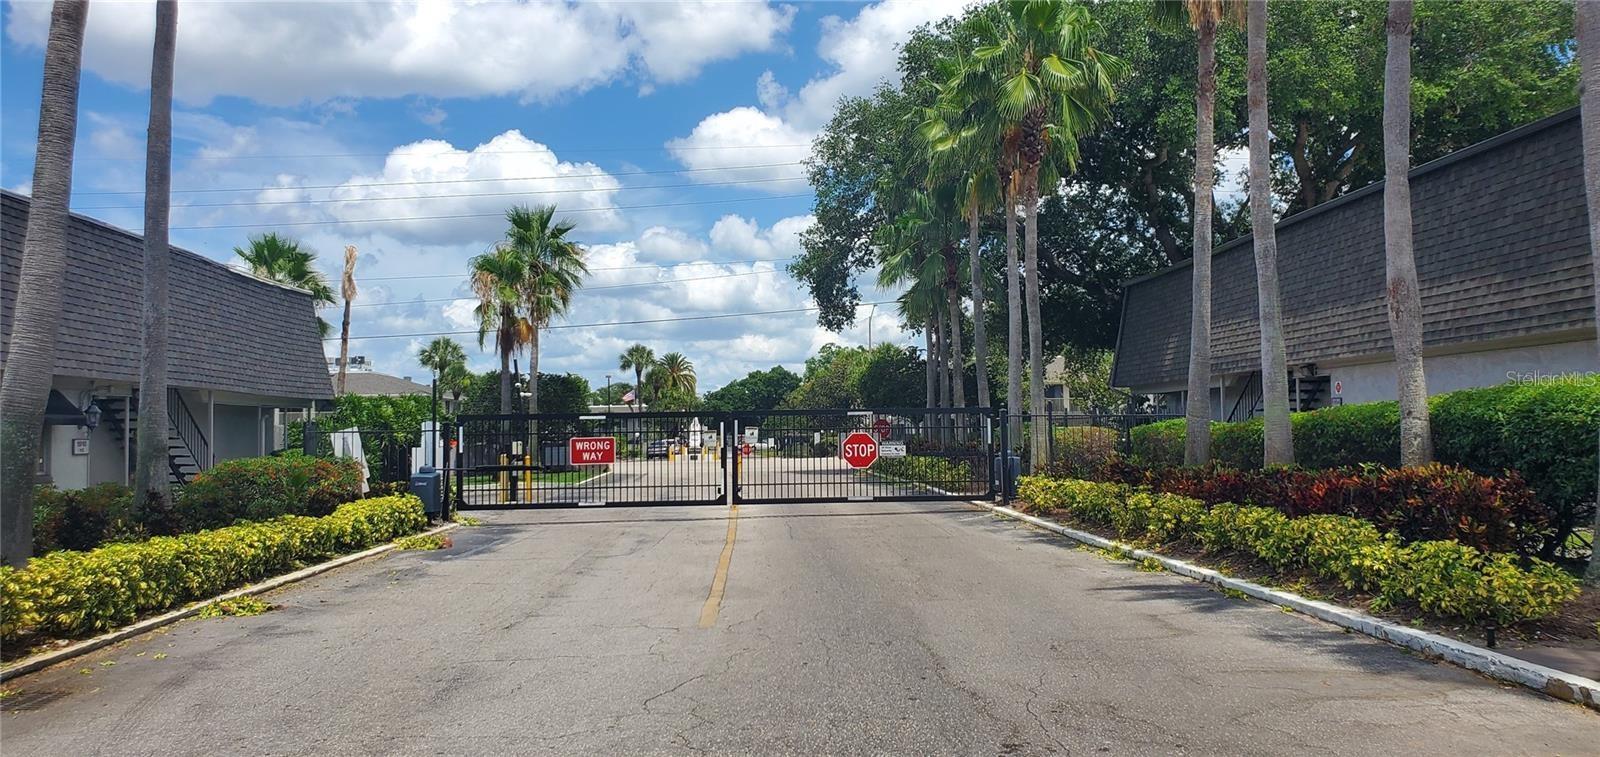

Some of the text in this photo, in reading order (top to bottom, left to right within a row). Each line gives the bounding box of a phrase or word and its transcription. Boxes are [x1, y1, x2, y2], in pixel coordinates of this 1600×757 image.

[873, 424, 890, 433] SOP
[575, 440, 611, 450] WRONG
[845, 443, 875, 458] STOP
[582, 451, 604, 461] WAY
